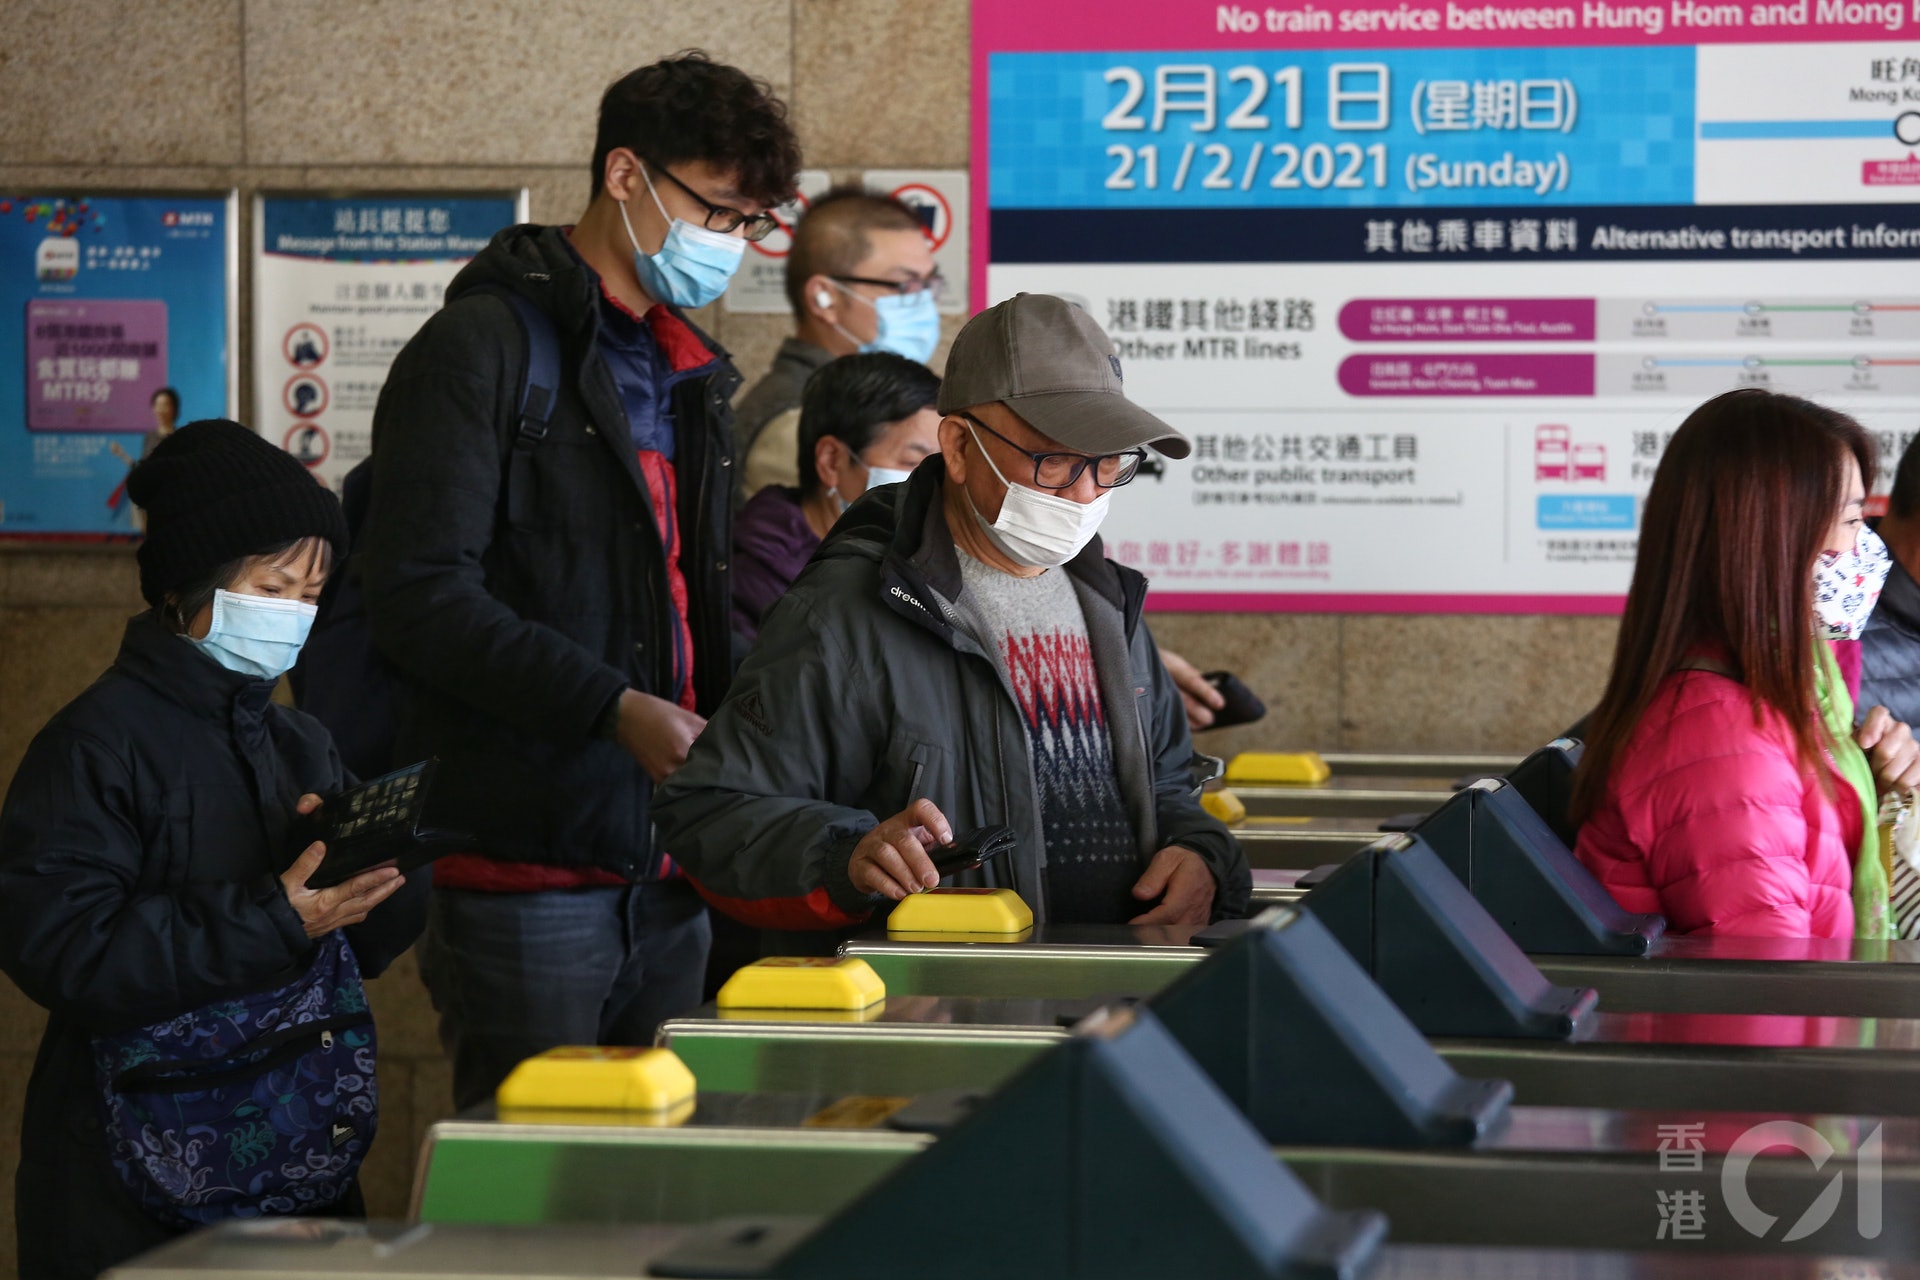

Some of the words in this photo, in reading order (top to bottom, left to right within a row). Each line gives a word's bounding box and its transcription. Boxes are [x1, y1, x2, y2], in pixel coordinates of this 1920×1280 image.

[1216, 5, 1260, 33] No
[1265, 4, 1332, 32] train
[1338, 3, 1440, 32] service
[1446, 2, 1576, 31] between
[1582, 1, 1663, 35] Hung
[1671, 0, 1743, 27] Hom
[1750, 0, 1808, 26] and
[1815, 0, 1903, 31] Mong
[1410, 78, 1579, 134] (星期日)
[1849, 86, 1898, 106] Mong
[1405, 152, 1569, 196] (Sunday)
[277, 233, 335, 254] Message
[338, 233, 367, 250] from
[372, 234, 394, 250] the
[397, 234, 442, 250] Station
[1364, 218, 1579, 252] 其他乘車資料
[1591, 224, 1727, 250] Alternative
[1730, 226, 1847, 254] transport
[1183, 337, 1238, 359] MTR
[1243, 337, 1302, 360] lines
[1195, 433, 1418, 463] 其他公共交通工具
[1191, 464, 1249, 485] Other
[1254, 463, 1317, 488] public
[1321, 466, 1415, 488] transport
